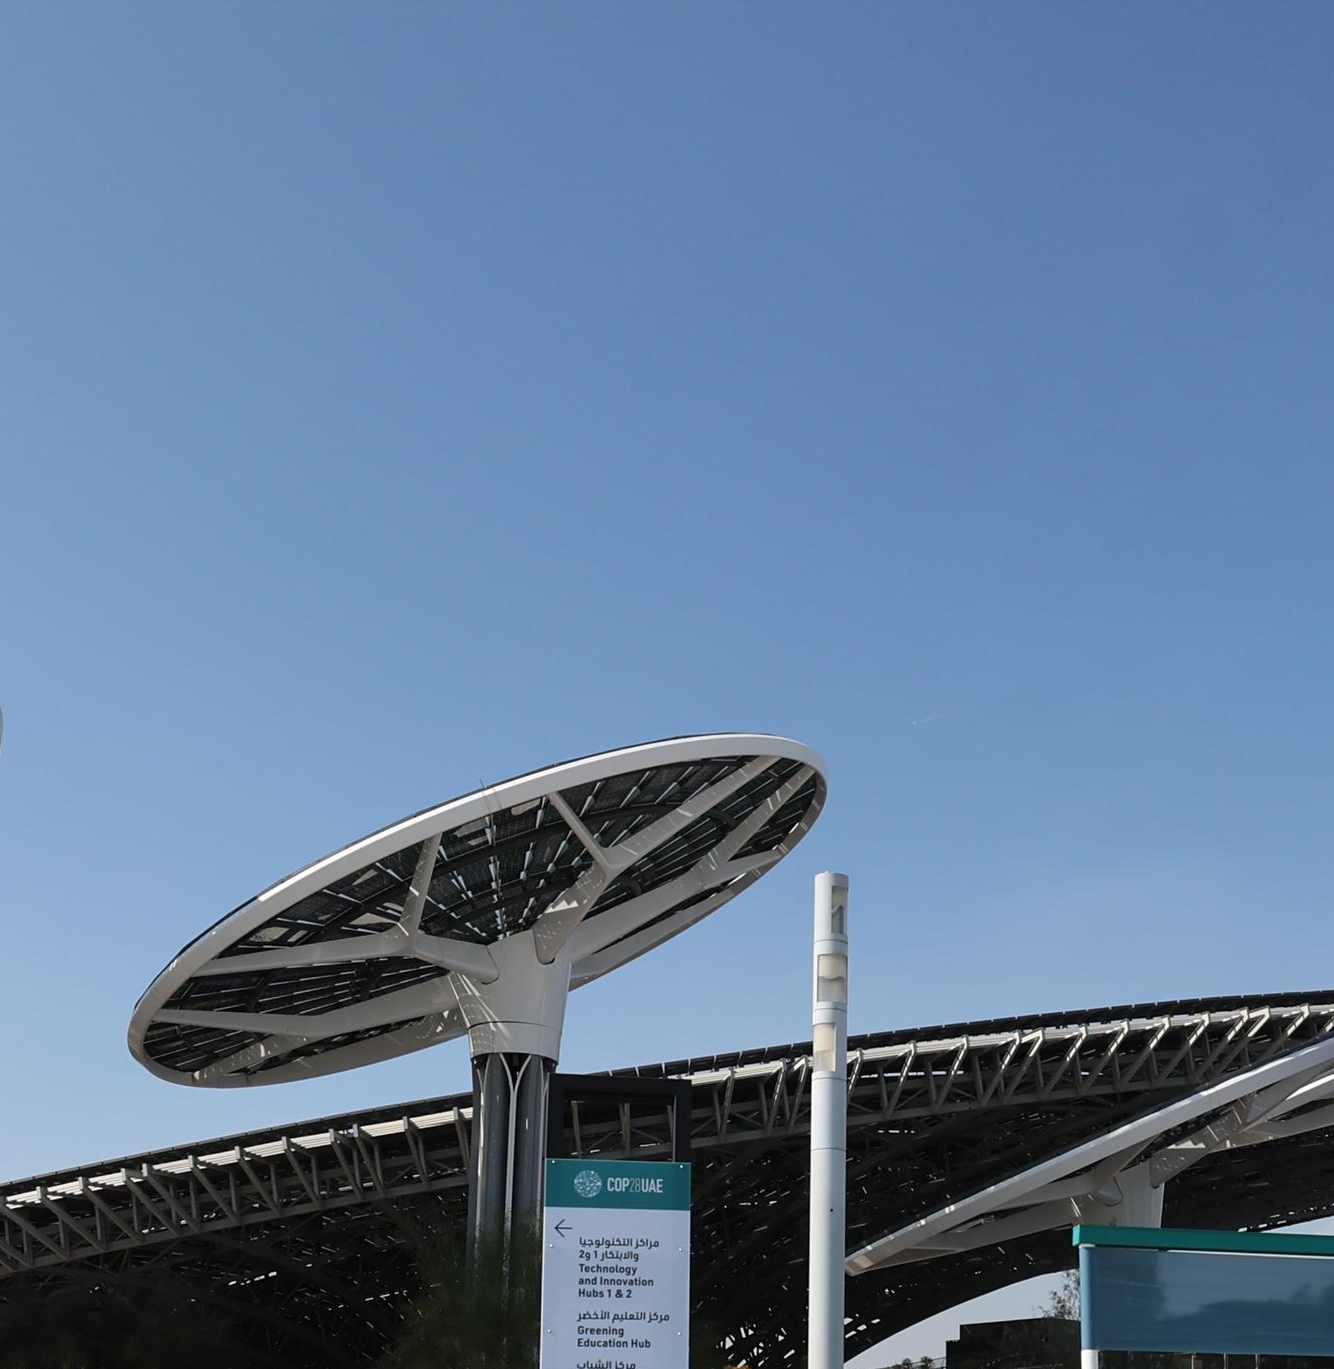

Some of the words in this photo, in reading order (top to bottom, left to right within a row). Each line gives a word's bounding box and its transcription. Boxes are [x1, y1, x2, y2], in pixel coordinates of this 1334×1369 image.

[607, 1177, 663, 1193] COP28UAE
[579, 1237, 632, 1248] التكنولوجيا
[634, 1238, 659, 1249] مراكز
[593, 1251, 598, 1259] 1
[600, 1250, 639, 1262] والابتكار
[579, 1264, 637, 1276] Technology
[578, 1277, 597, 1285] and
[600, 1277, 654, 1286] Innovation
[578, 1288, 604, 1298] Hubs
[607, 1289, 612, 1298] 1
[615, 1289, 623, 1298] &
[626, 1289, 632, 1298] 2
[577, 1310, 610, 1322] الأخضر
[612, 1311, 646, 1324] التعليم
[647, 1312, 670, 1324] مركز
[577, 1325, 625, 1338] Greening
[577, 1338, 629, 1348] Education
[631, 1339, 651, 1348] Hub
